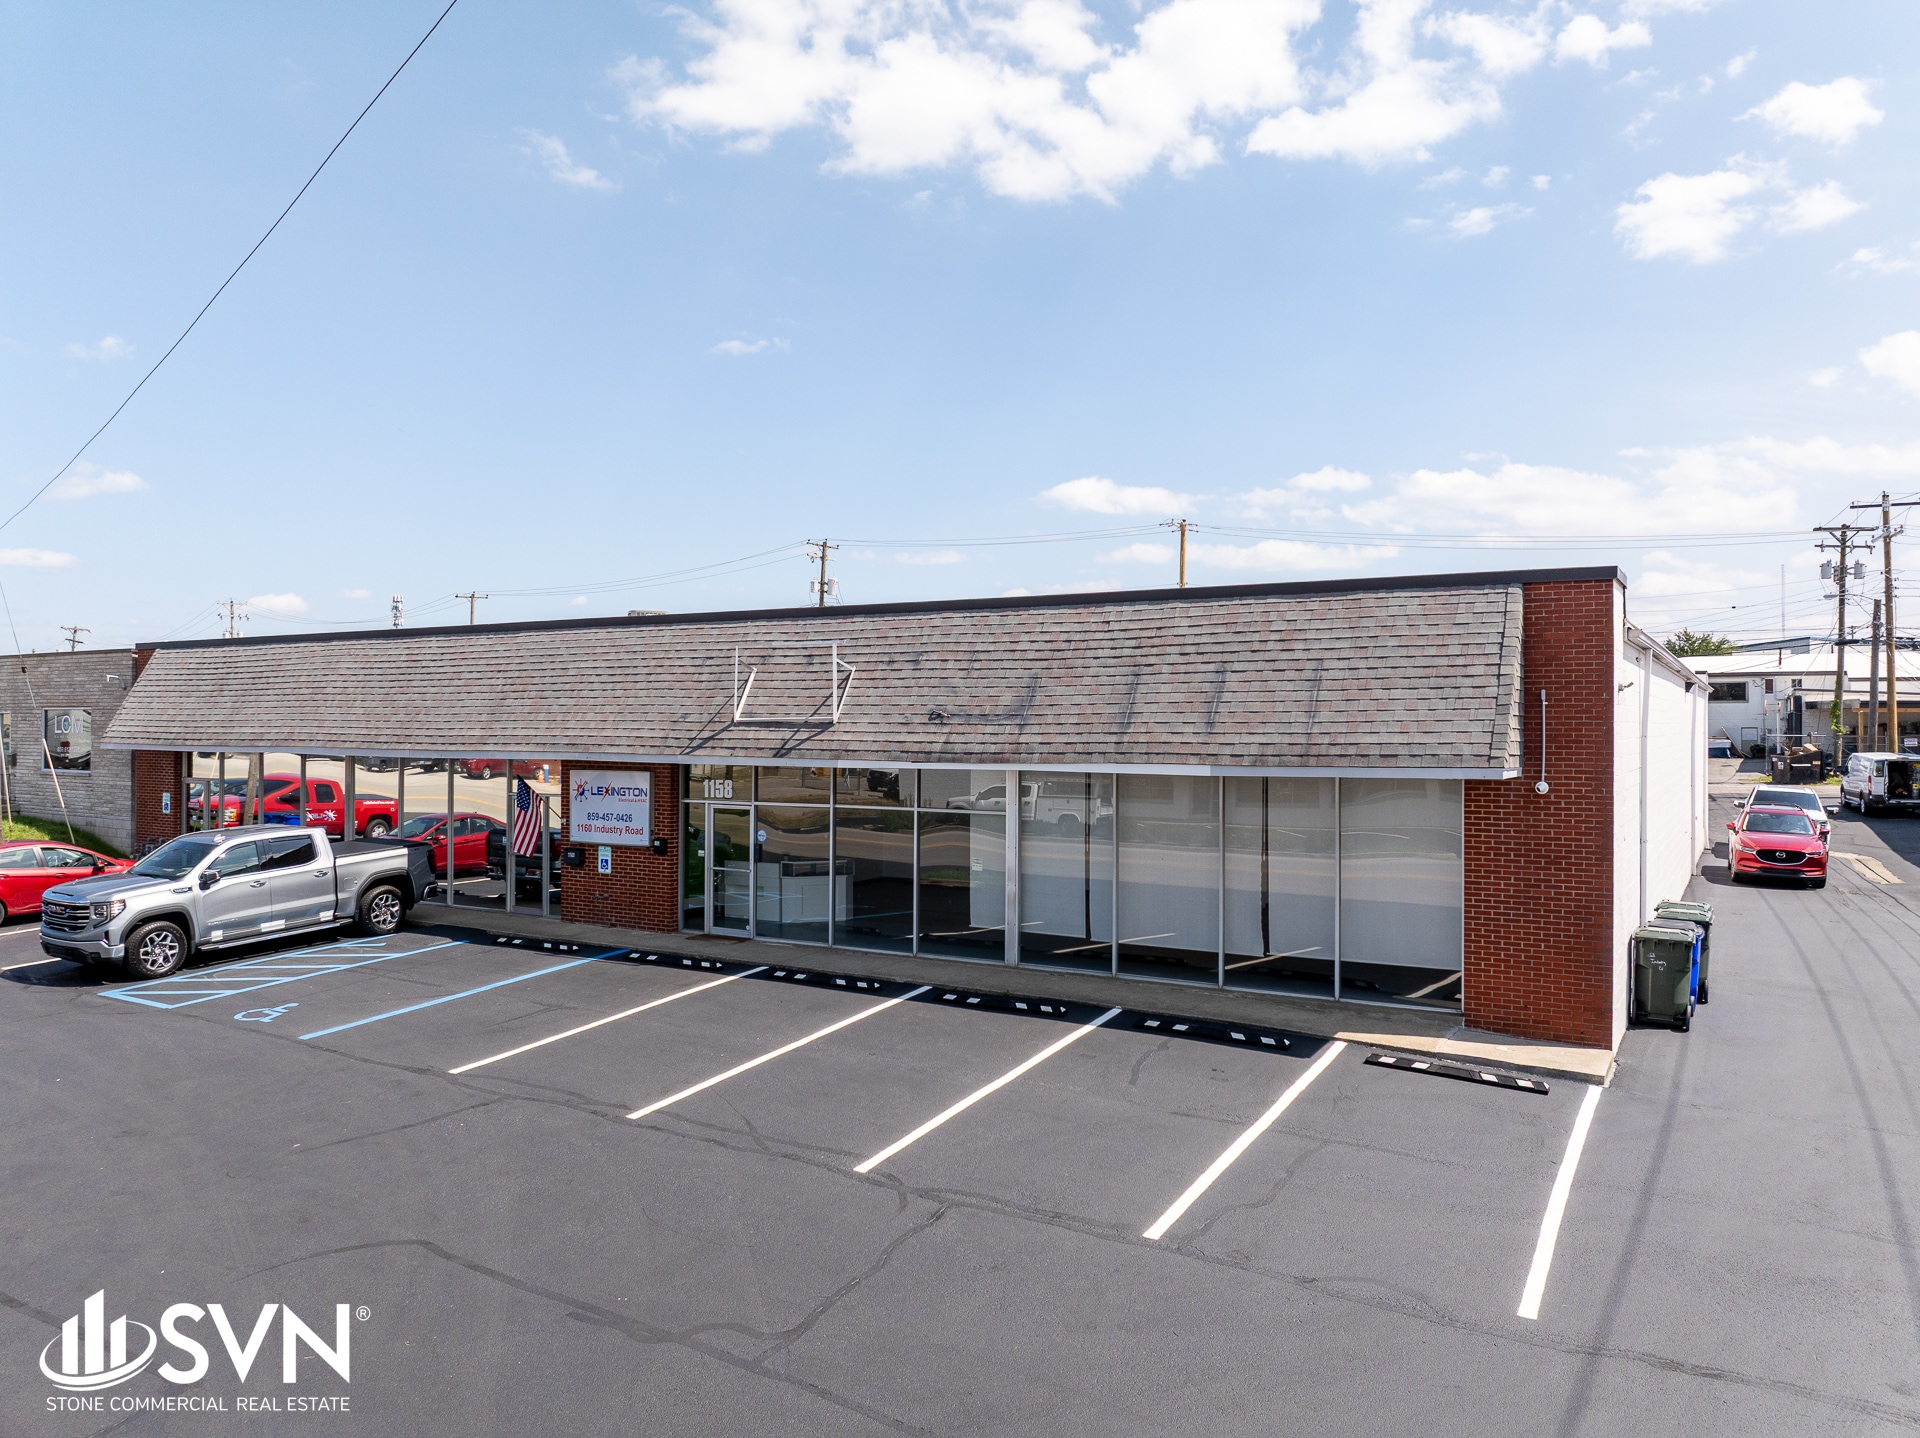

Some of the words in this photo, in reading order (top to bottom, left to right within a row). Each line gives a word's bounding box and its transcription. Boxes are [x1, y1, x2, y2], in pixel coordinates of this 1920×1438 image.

[54, 715, 84, 734] LCM
[590, 785, 648, 798] LEXINGTON
[703, 779, 733, 799] 1158
[587, 812, 633, 823] 859-457-0426
[577, 823, 592, 833] 1160
[594, 824, 623, 836] Industry
[625, 825, 644, 835] Road
